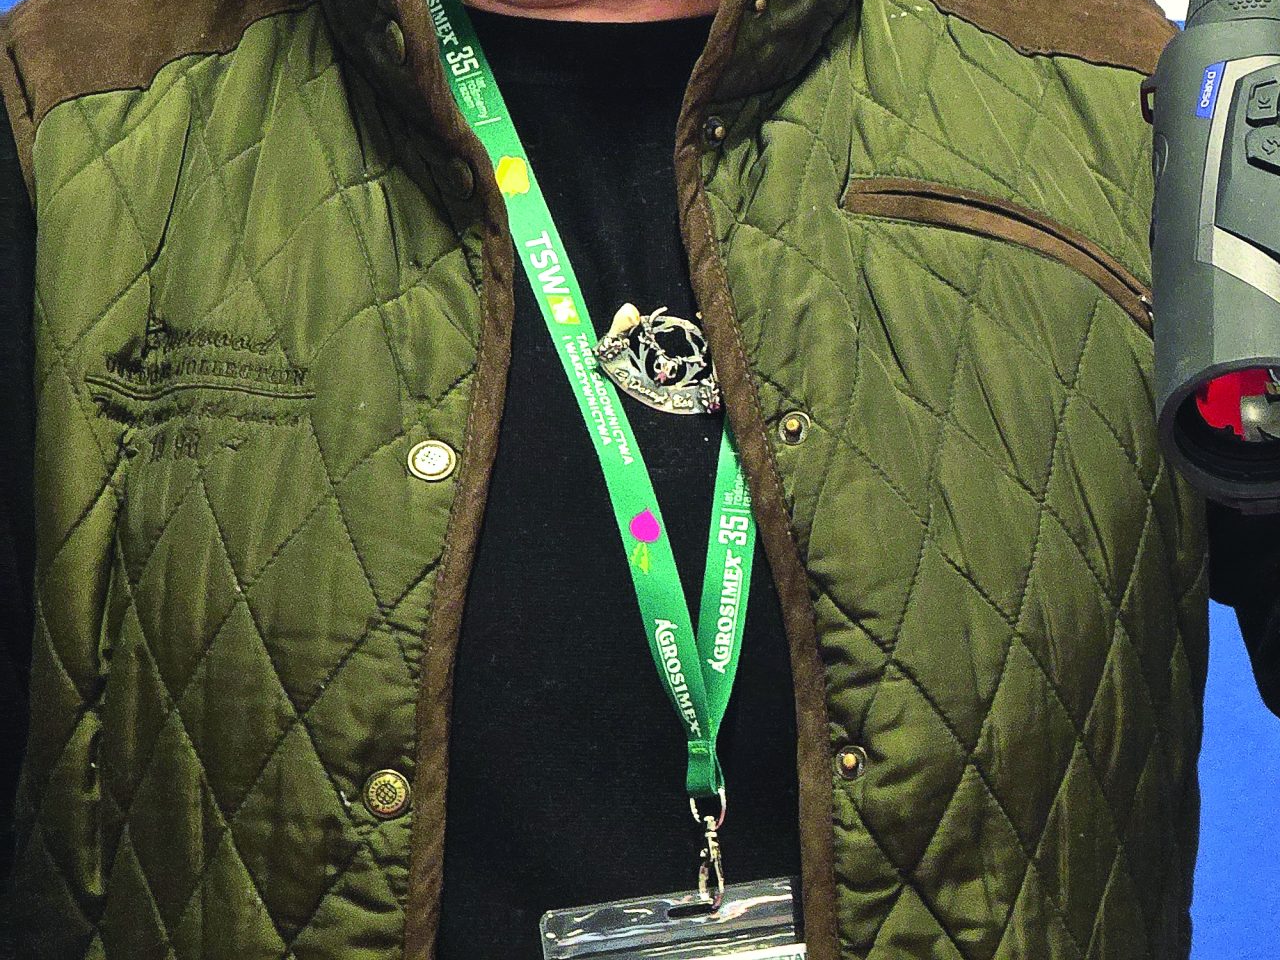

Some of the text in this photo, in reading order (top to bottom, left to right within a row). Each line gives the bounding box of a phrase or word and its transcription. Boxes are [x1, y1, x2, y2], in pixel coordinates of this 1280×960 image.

[446, 45, 480, 76] 35
[525, 230, 571, 295] TSW
[563, 341, 611, 447] WARZYWNICTWA
[575, 332, 634, 466] TARGI SADOWNICTWA
[706, 514, 748, 674] AGROSIMEX 35
[654, 617, 702, 738] AGROSIMEX
